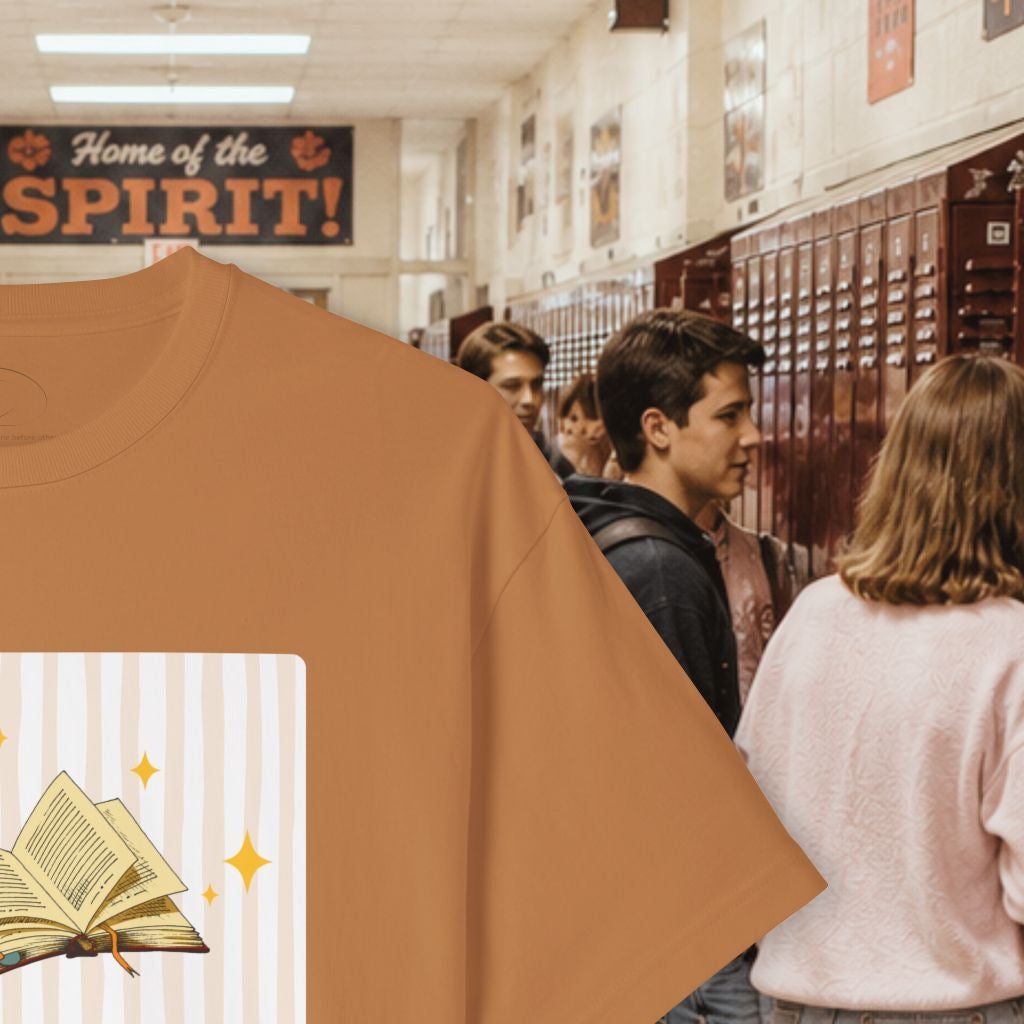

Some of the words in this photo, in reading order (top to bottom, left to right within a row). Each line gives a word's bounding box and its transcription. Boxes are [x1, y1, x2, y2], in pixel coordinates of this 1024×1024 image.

[71, 131, 165, 166] Home
[171, 134, 211, 176] of
[214, 132, 268, 166] the
[1, 176, 343, 238] SPIRIT!
